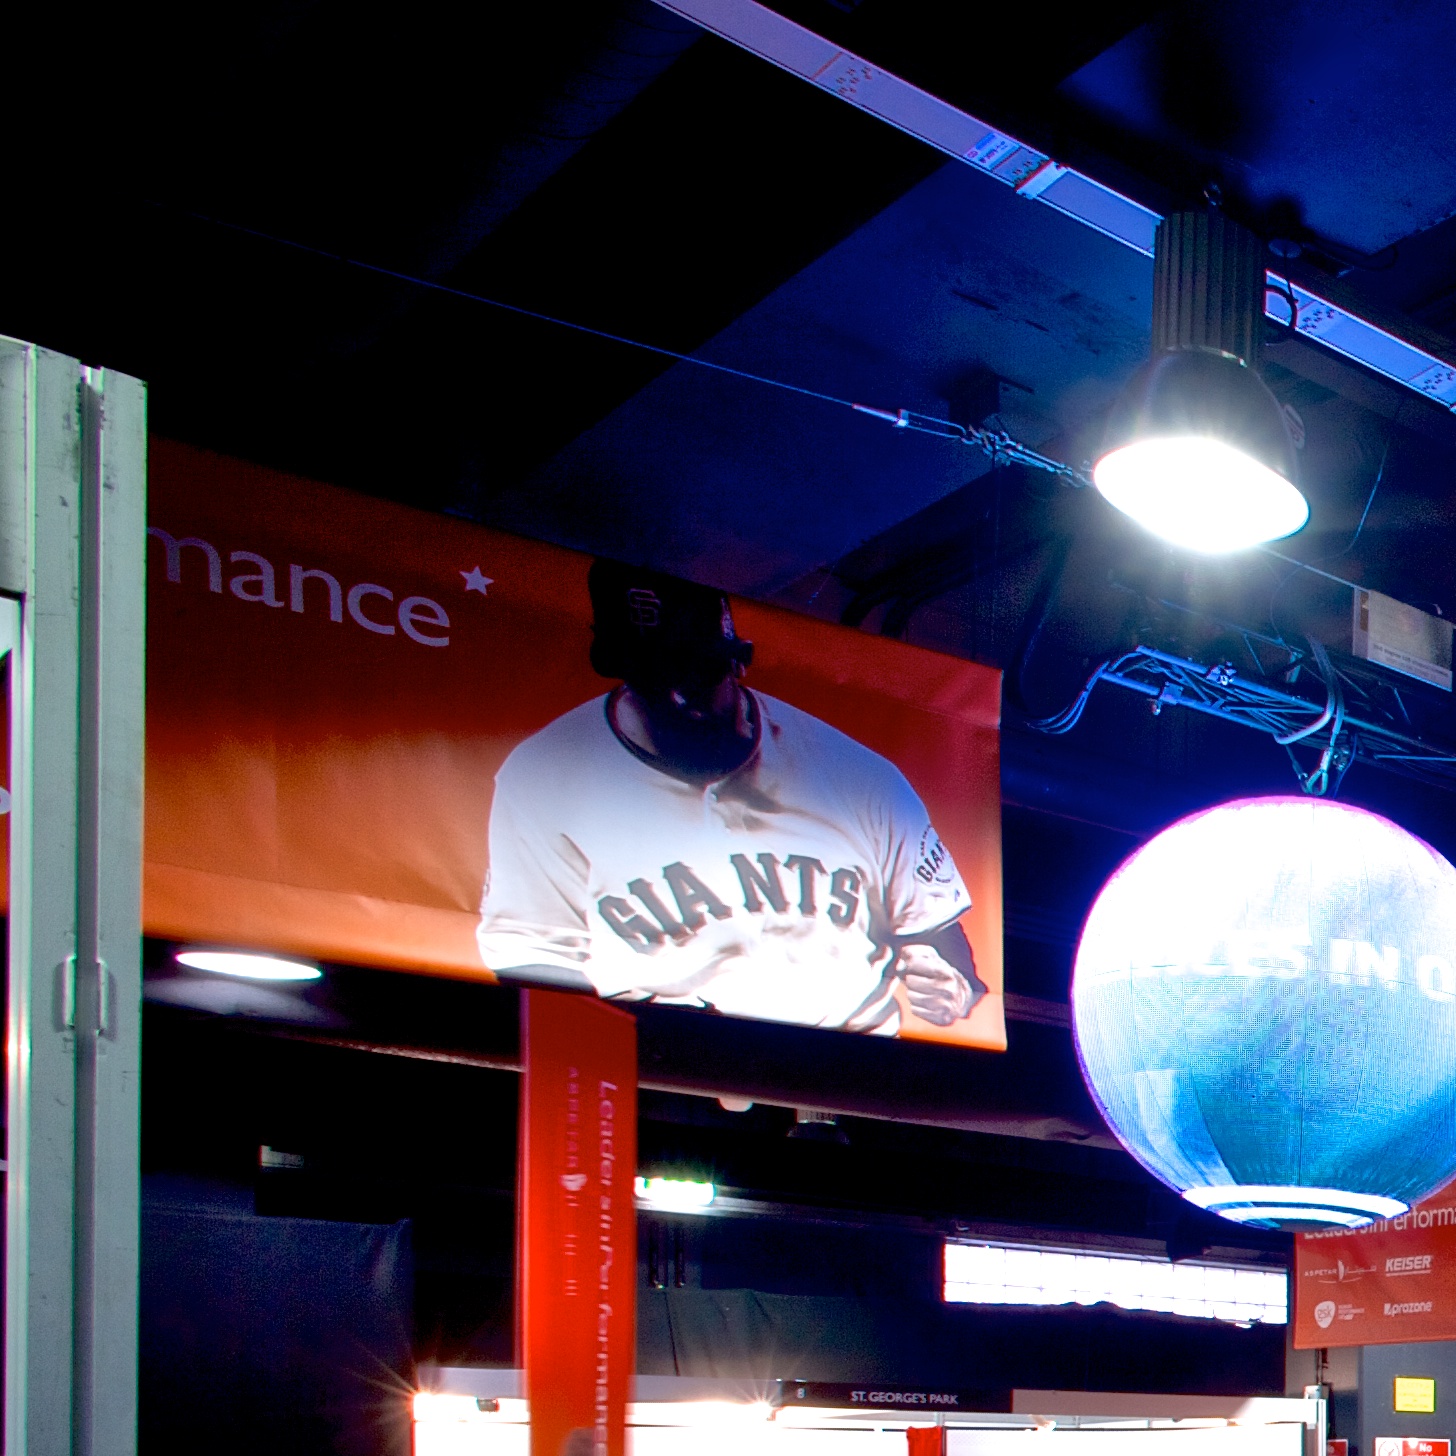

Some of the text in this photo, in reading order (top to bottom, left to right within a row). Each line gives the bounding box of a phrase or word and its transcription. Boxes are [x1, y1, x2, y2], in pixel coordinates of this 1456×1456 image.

[596, 852, 865, 952] GIANTS
[1385, 1255, 1432, 1272] KEISER
[1391, 1302, 1433, 1317] prozone
[869, 1391, 927, 1404] GEORGE'S
[929, 1393, 959, 1405] PARK
[1419, 1443, 1432, 1452] No
